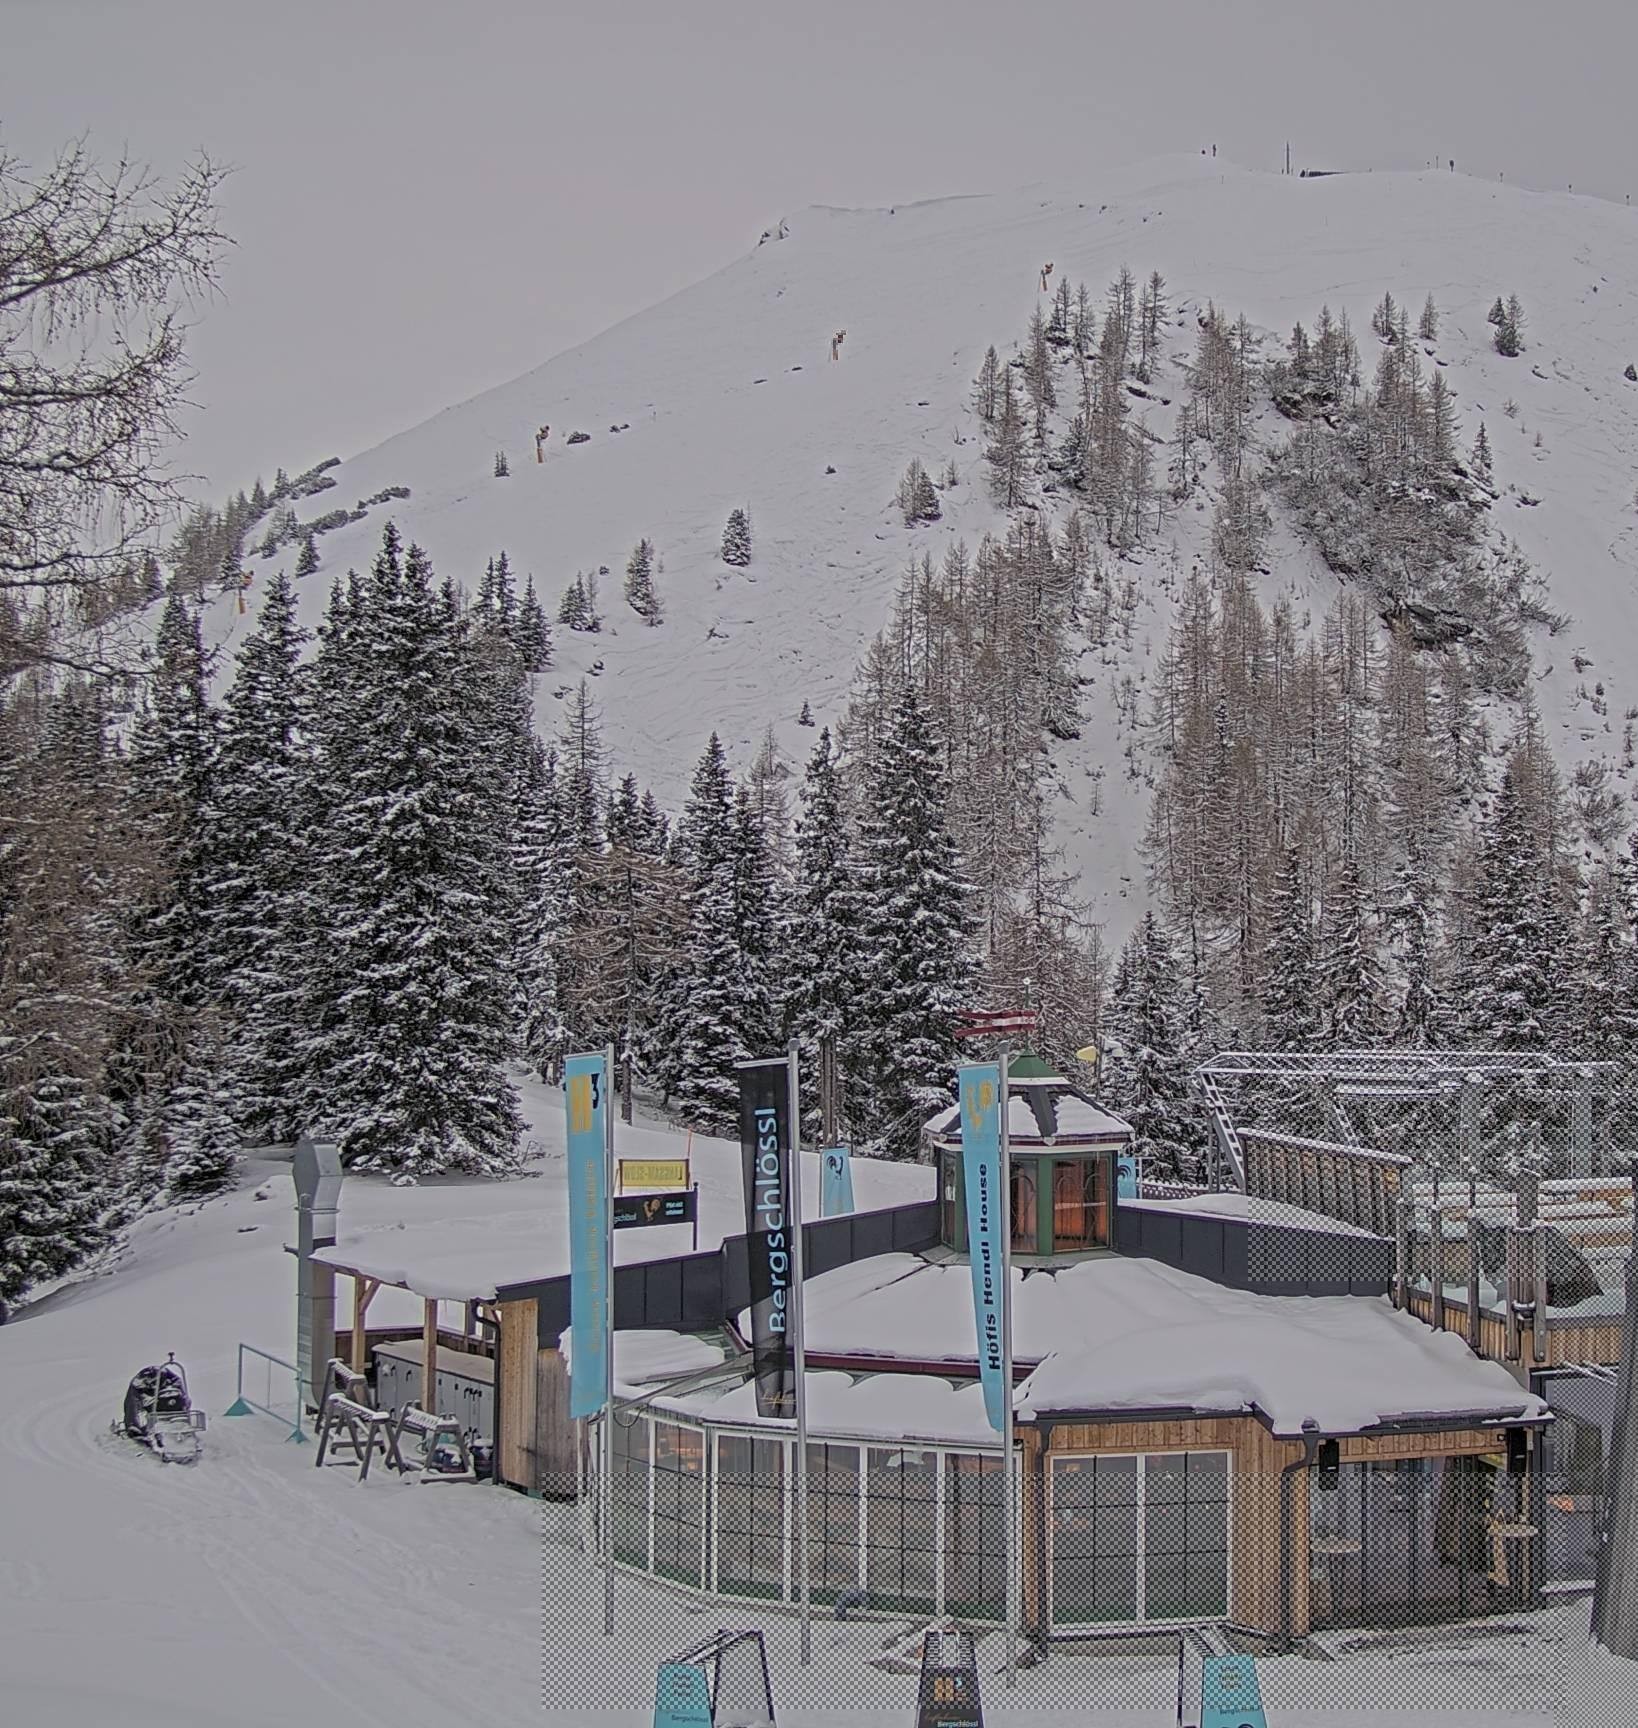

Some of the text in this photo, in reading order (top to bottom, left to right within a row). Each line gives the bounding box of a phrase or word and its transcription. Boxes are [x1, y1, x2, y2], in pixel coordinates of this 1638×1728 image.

[754, 1108, 788, 1333] Bergschlössl
[979, 1164, 1001, 1370] Höfis Hendl House
